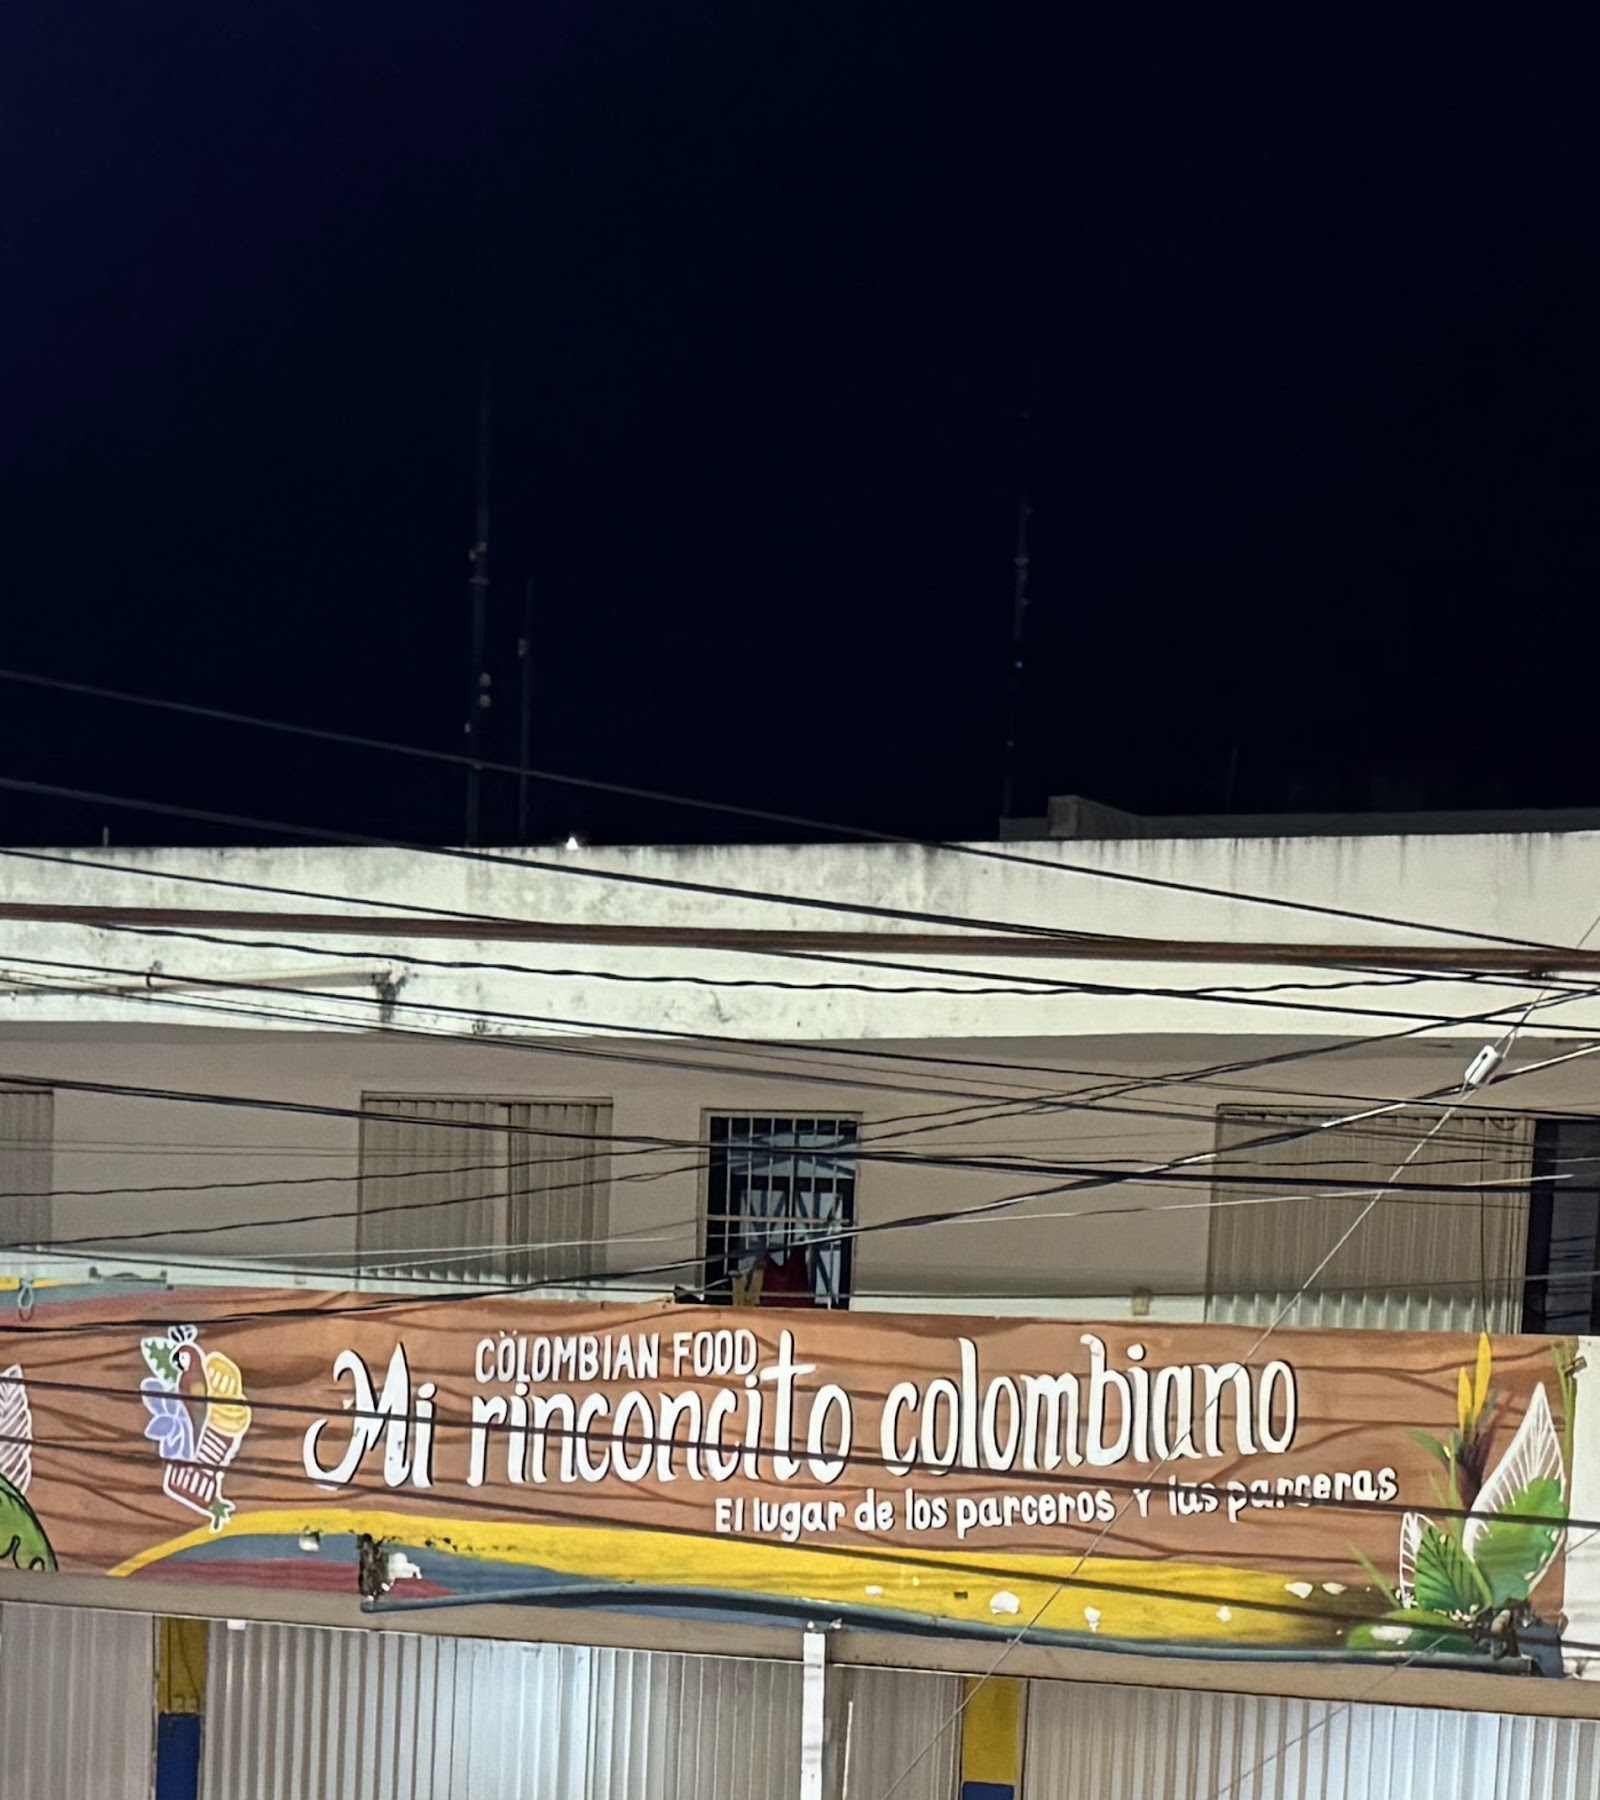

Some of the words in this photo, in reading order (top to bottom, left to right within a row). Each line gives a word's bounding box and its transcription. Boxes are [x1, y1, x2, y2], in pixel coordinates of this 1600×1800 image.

[673, 1328, 758, 1378] FOOD
[303, 1342, 434, 1489] Mi
[467, 1328, 853, 1488] rinconcito
[880, 1333, 1298, 1477] colombiano
[715, 1497, 745, 1533] El
[753, 1496, 847, 1543] lugar
[854, 1487, 895, 1531] de
[905, 1487, 949, 1531] los
[956, 1489, 1116, 1540] parceros
[1226, 1466, 1398, 1524] parceras
